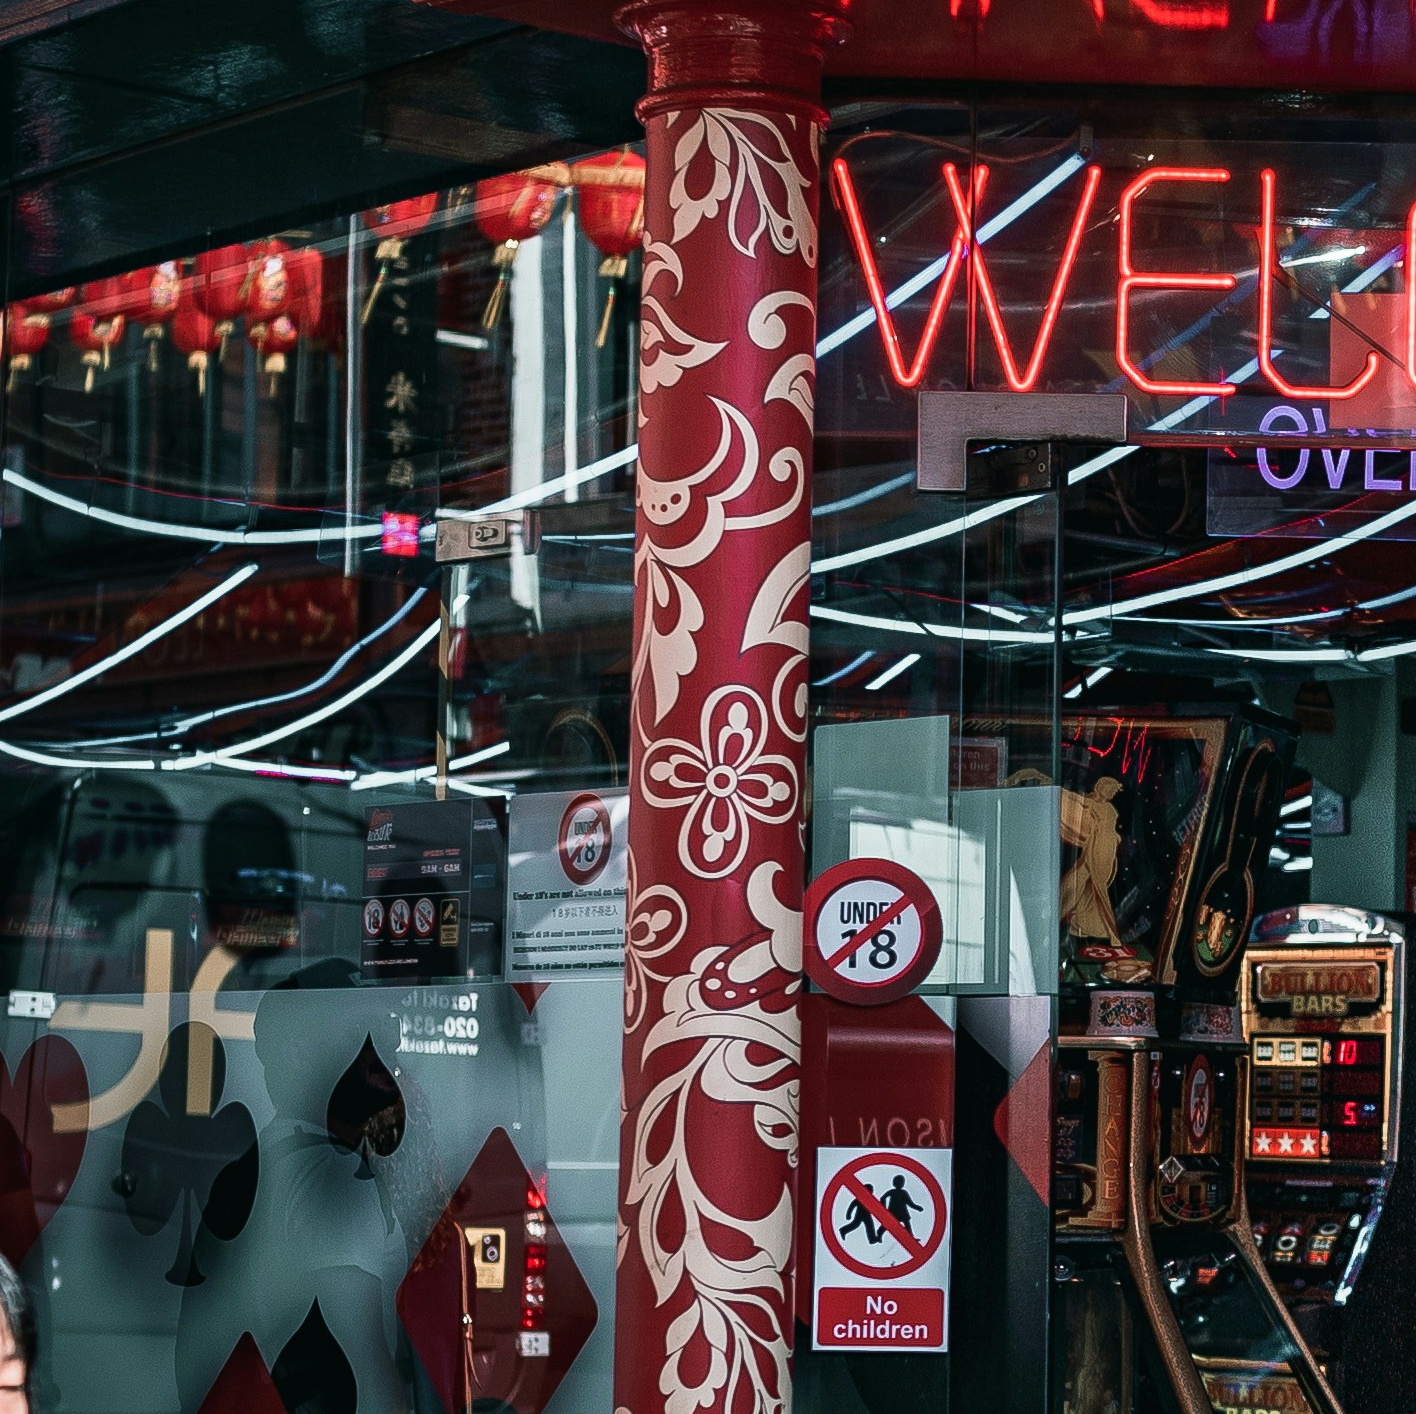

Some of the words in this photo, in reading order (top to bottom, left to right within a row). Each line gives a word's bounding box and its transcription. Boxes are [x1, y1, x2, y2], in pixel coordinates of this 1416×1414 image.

[840, 900, 903, 925] UNDER
[840, 928, 899, 971] 18
[1292, 994, 1348, 1014] BARS
[865, 1295, 899, 1316] No
[832, 1318, 929, 1341] children
